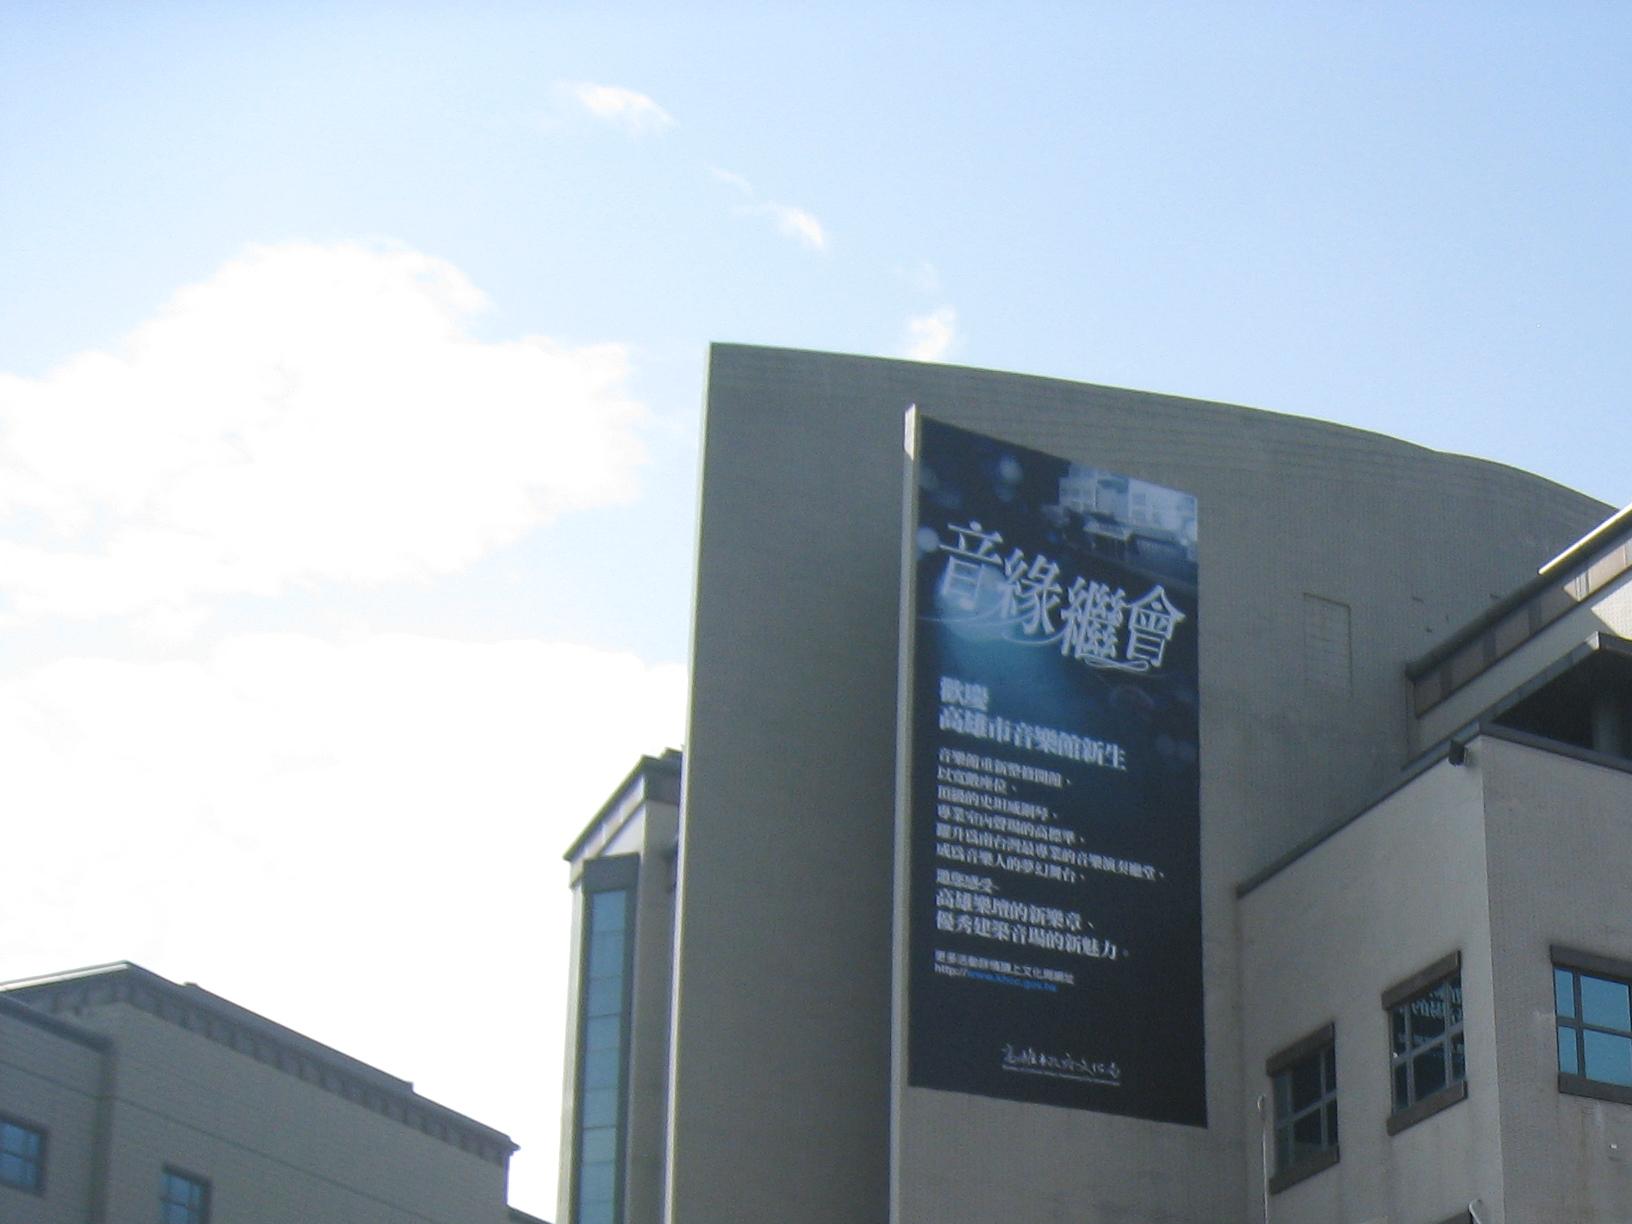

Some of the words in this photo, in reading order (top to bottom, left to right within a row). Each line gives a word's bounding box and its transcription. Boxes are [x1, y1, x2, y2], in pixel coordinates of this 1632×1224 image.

[938, 702, 1126, 771] 高雄市音樂館新生
